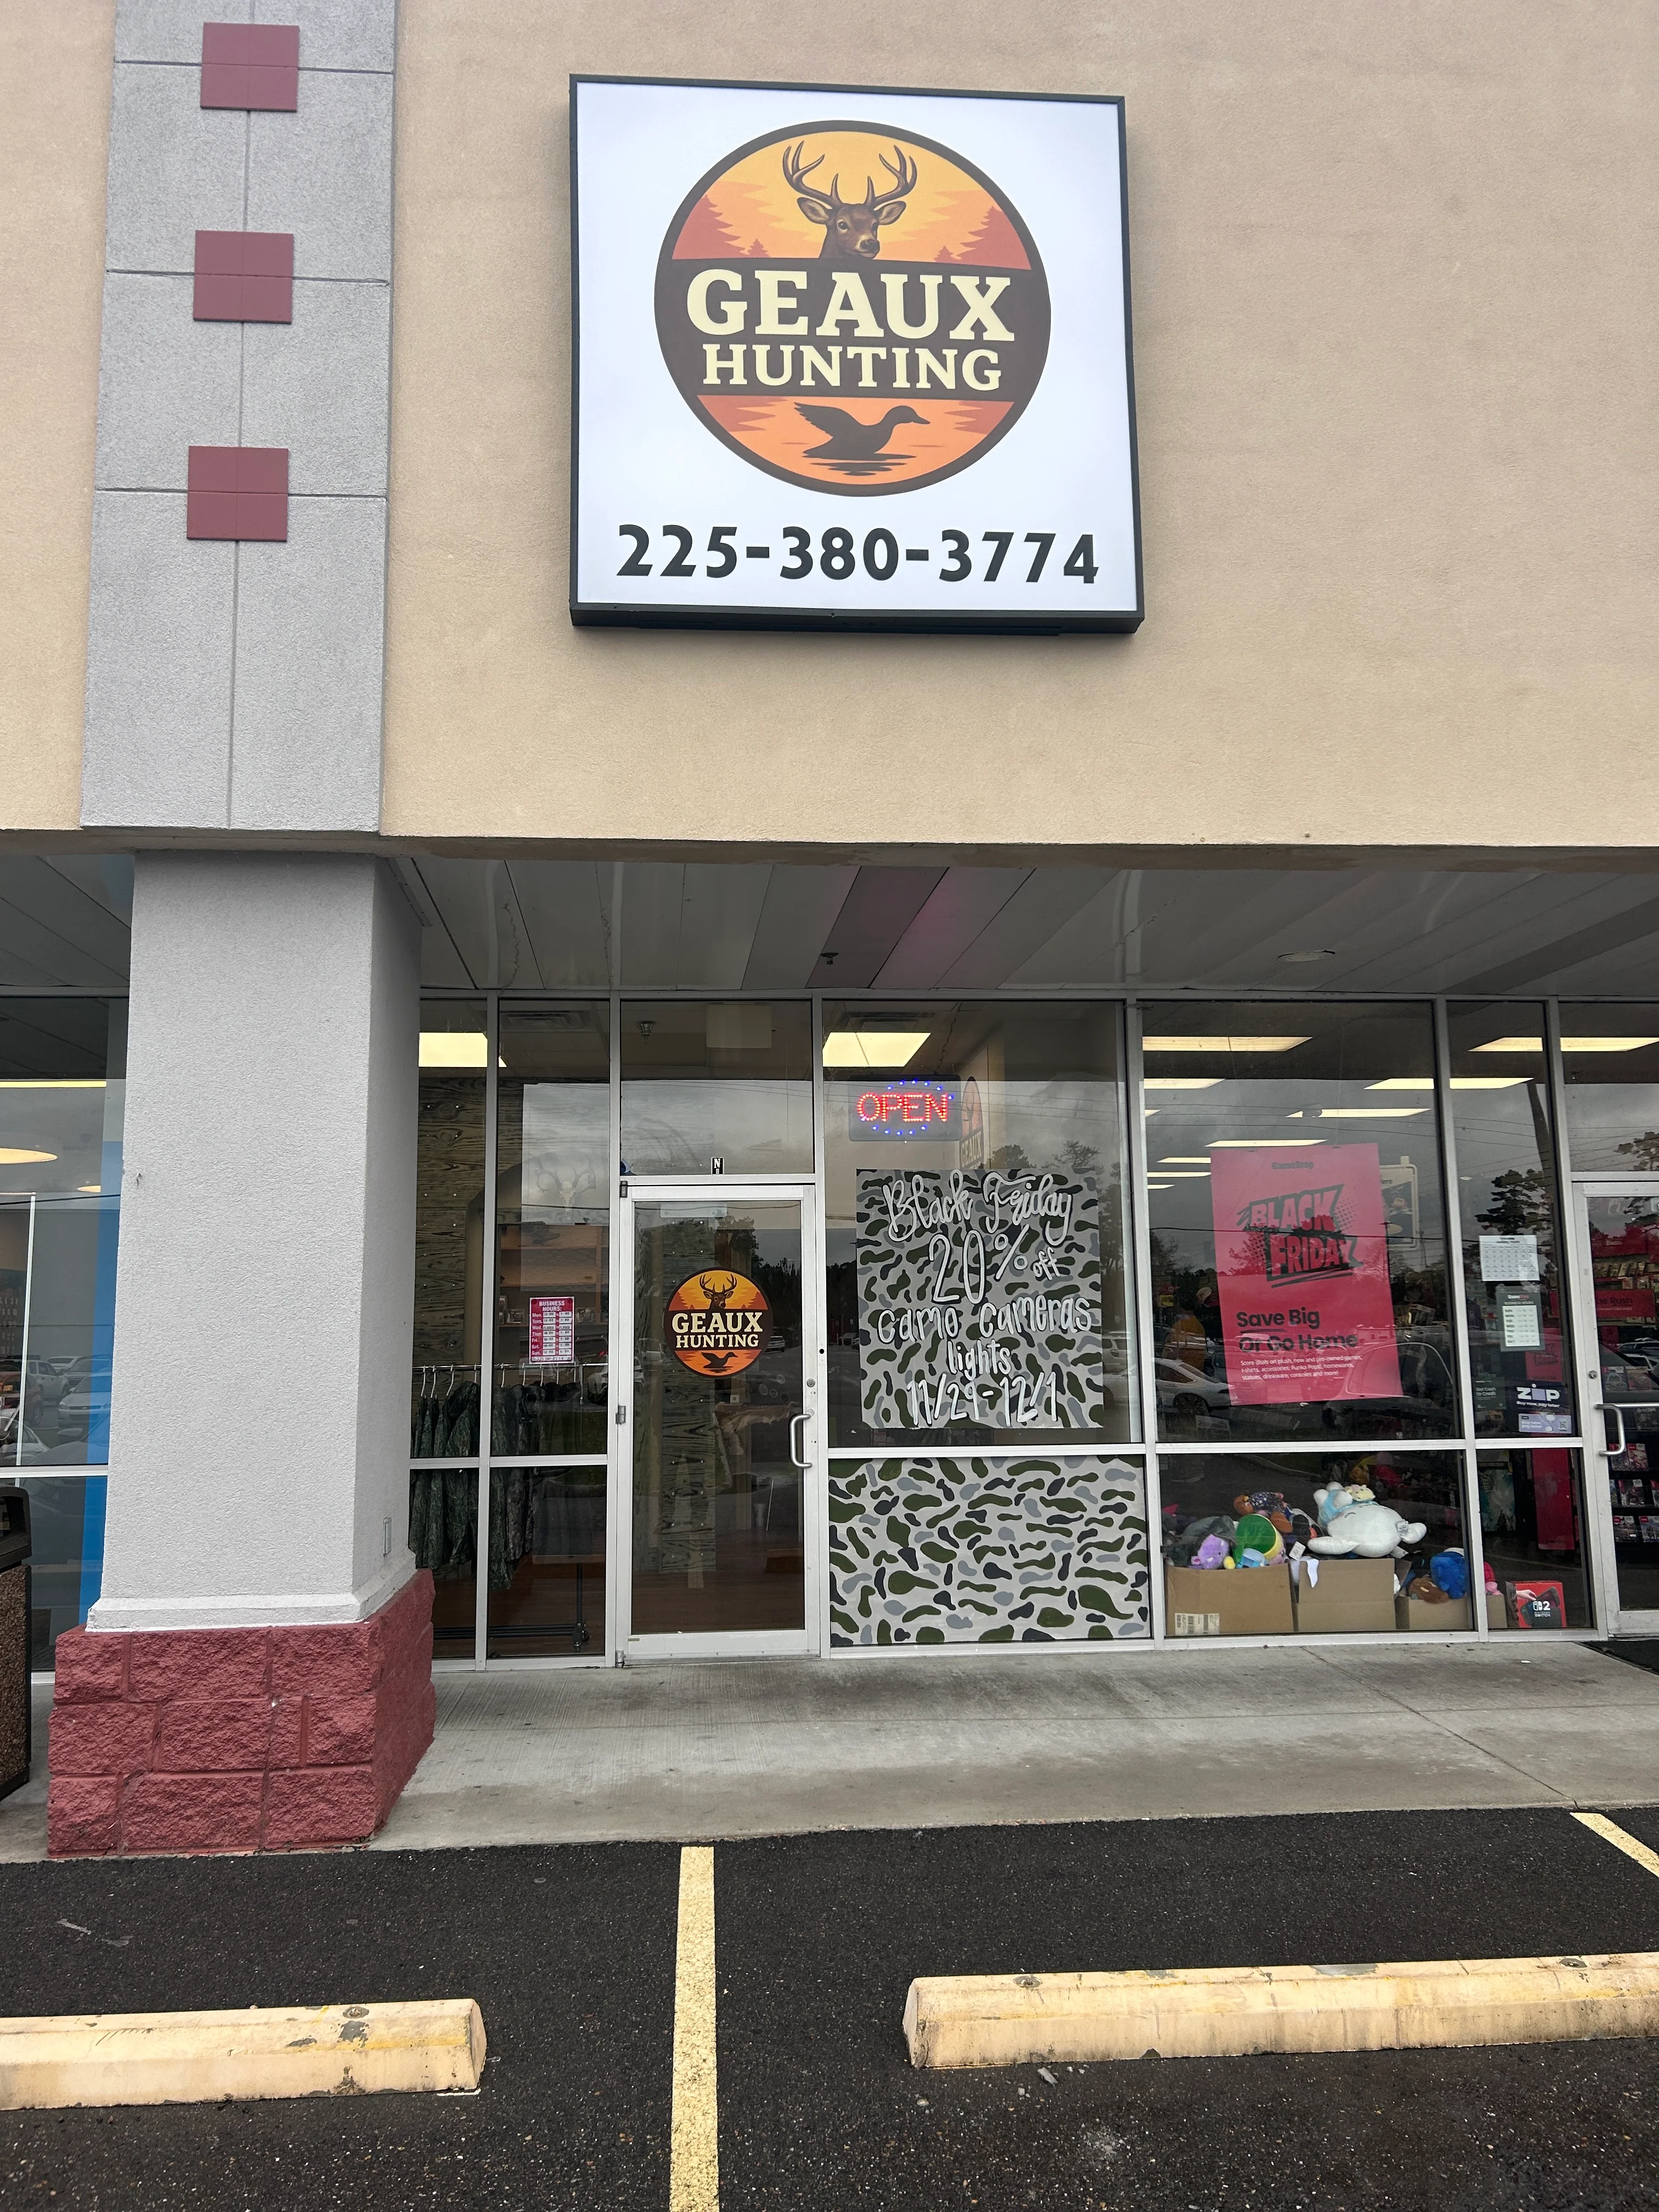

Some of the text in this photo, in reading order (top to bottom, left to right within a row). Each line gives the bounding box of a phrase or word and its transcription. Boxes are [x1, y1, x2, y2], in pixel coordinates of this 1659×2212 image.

[686, 268, 1015, 342] GEAUX
[703, 343, 1001, 391] HUNTING
[617, 524, 1099, 584] 225-380-3774
[857, 1092, 947, 1122] OPEN
[961, 1131, 982, 1168] GEAUX
[1272, 1161, 1314, 1169] GameStop
[882, 1169, 1073, 1246] Black Friday
[1250, 1190, 1338, 1231] BLACK
[928, 1223, 1060, 1304] 20% off
[1270, 1235, 1353, 1277] FRIDAY
[672, 1312, 763, 1334] GEAUX
[1236, 1307, 1321, 1329] Save Big
[675, 1334, 759, 1348] HUNTING
[946, 1339, 1012, 1381] lights
[1239, 1334, 1358, 1353] Or Go Home
[1543, 1600, 1551, 1611] 2
